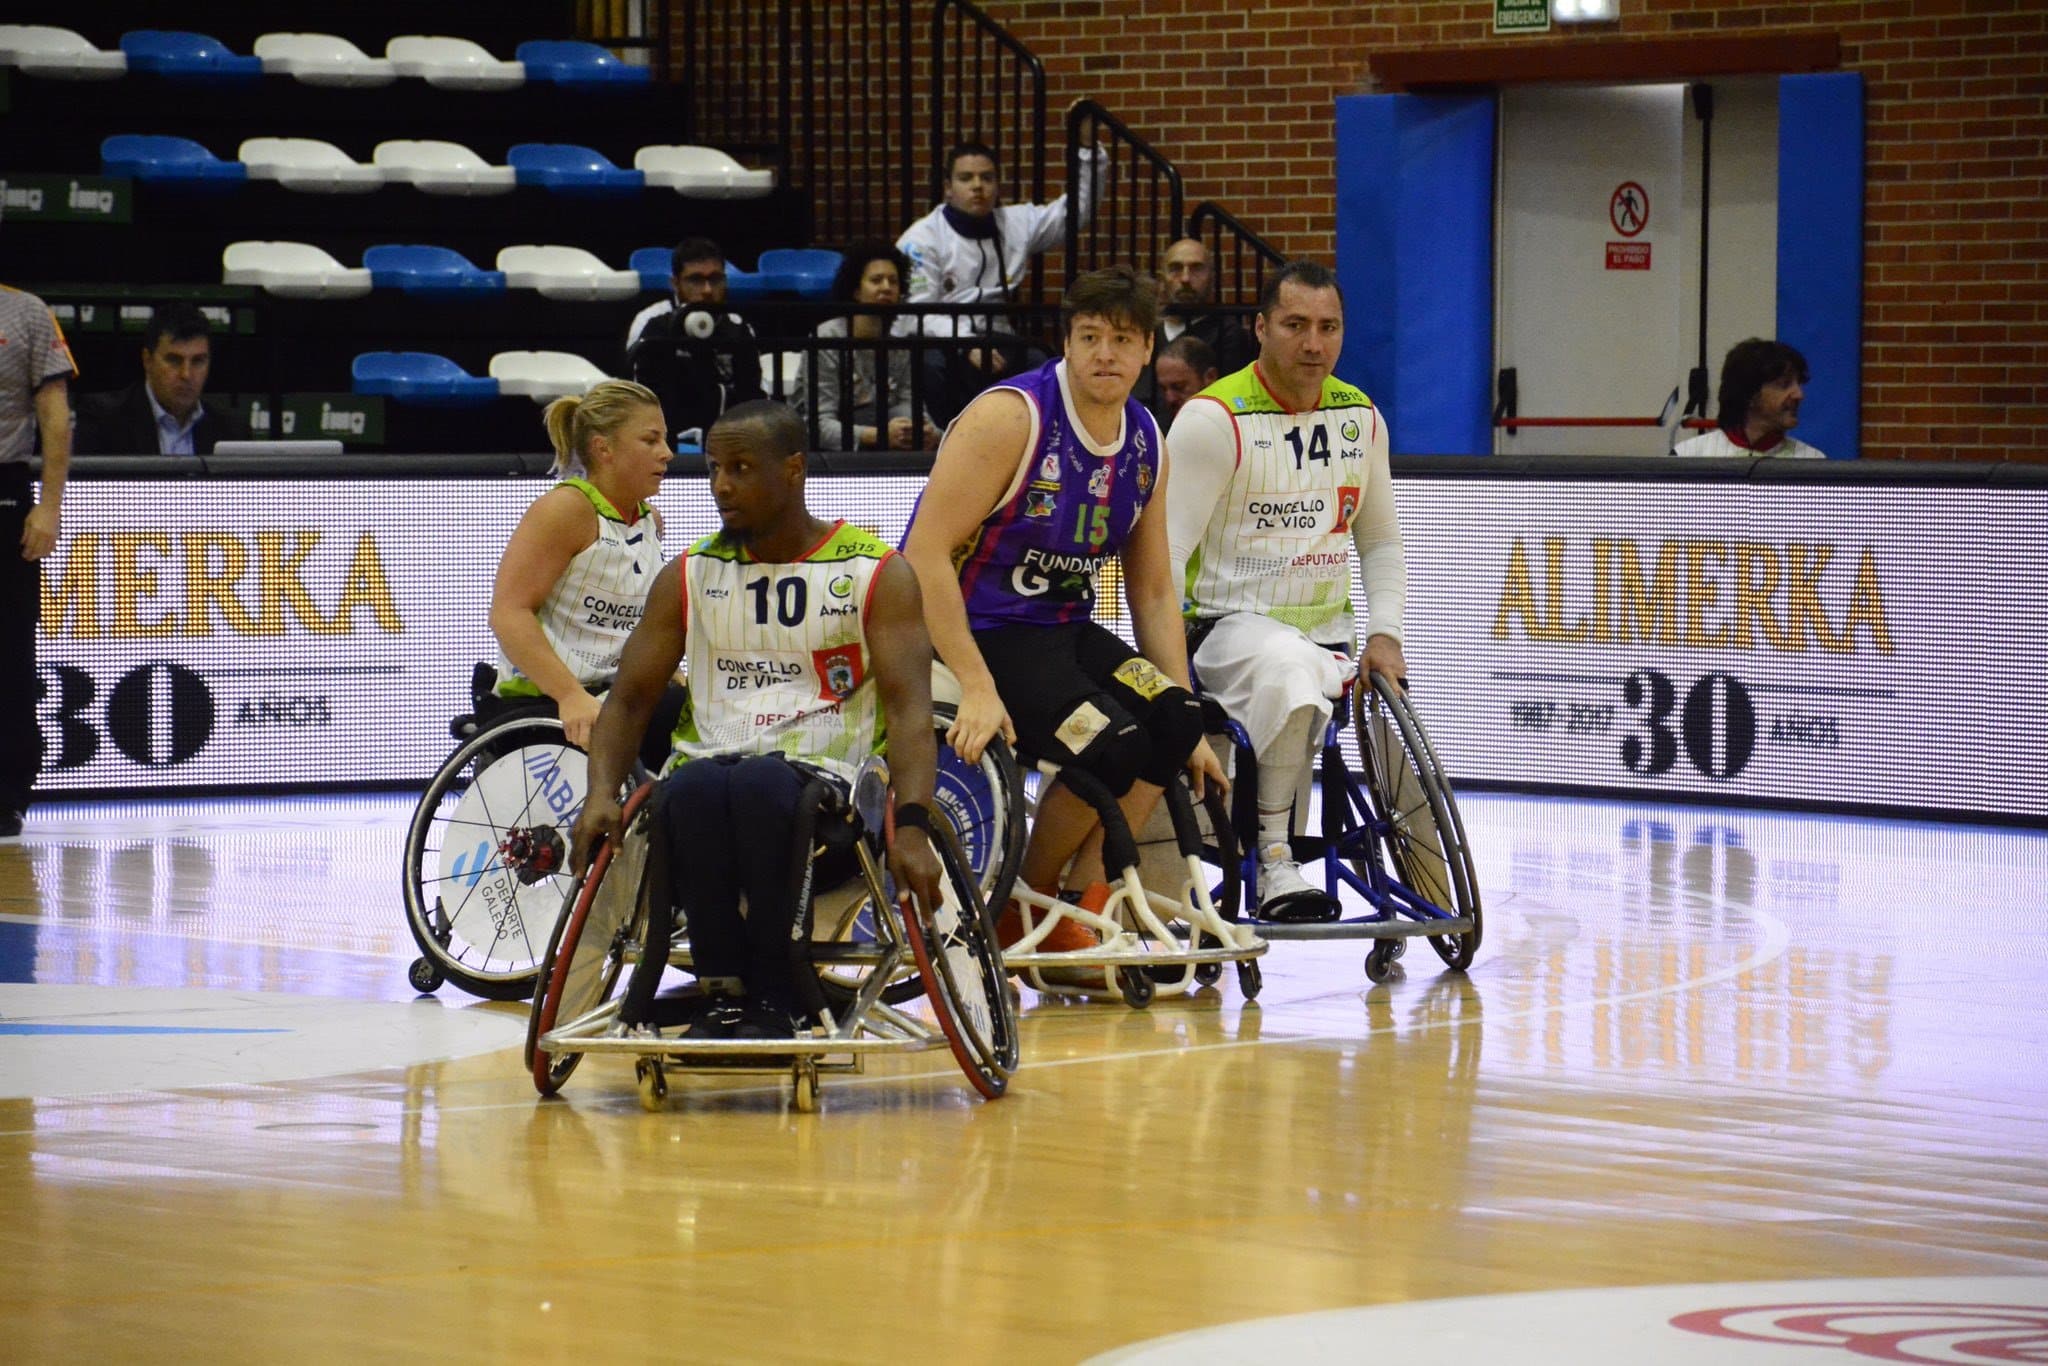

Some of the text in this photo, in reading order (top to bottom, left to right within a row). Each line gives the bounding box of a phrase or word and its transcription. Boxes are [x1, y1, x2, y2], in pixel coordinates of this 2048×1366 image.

[1284, 424, 1331, 470] 14
[1073, 503, 1111, 545] 15
[1249, 499, 1325, 516] CONCELLO
[1280, 517, 1316, 529] VIGO
[583, 595, 644, 618] CONCELL
[746, 576, 808, 628] 10
[1491, 535, 1897, 656] ALIMERKA
[587, 613, 637, 632] DE VIG
[717, 658, 802, 676] CONCELLO
[727, 676, 747, 690] DE
[36, 659, 216, 773] 30
[1619, 667, 1757, 782] 30
[481, 885, 508, 941] GALEGO
[493, 878, 523, 940] DEPORTE
